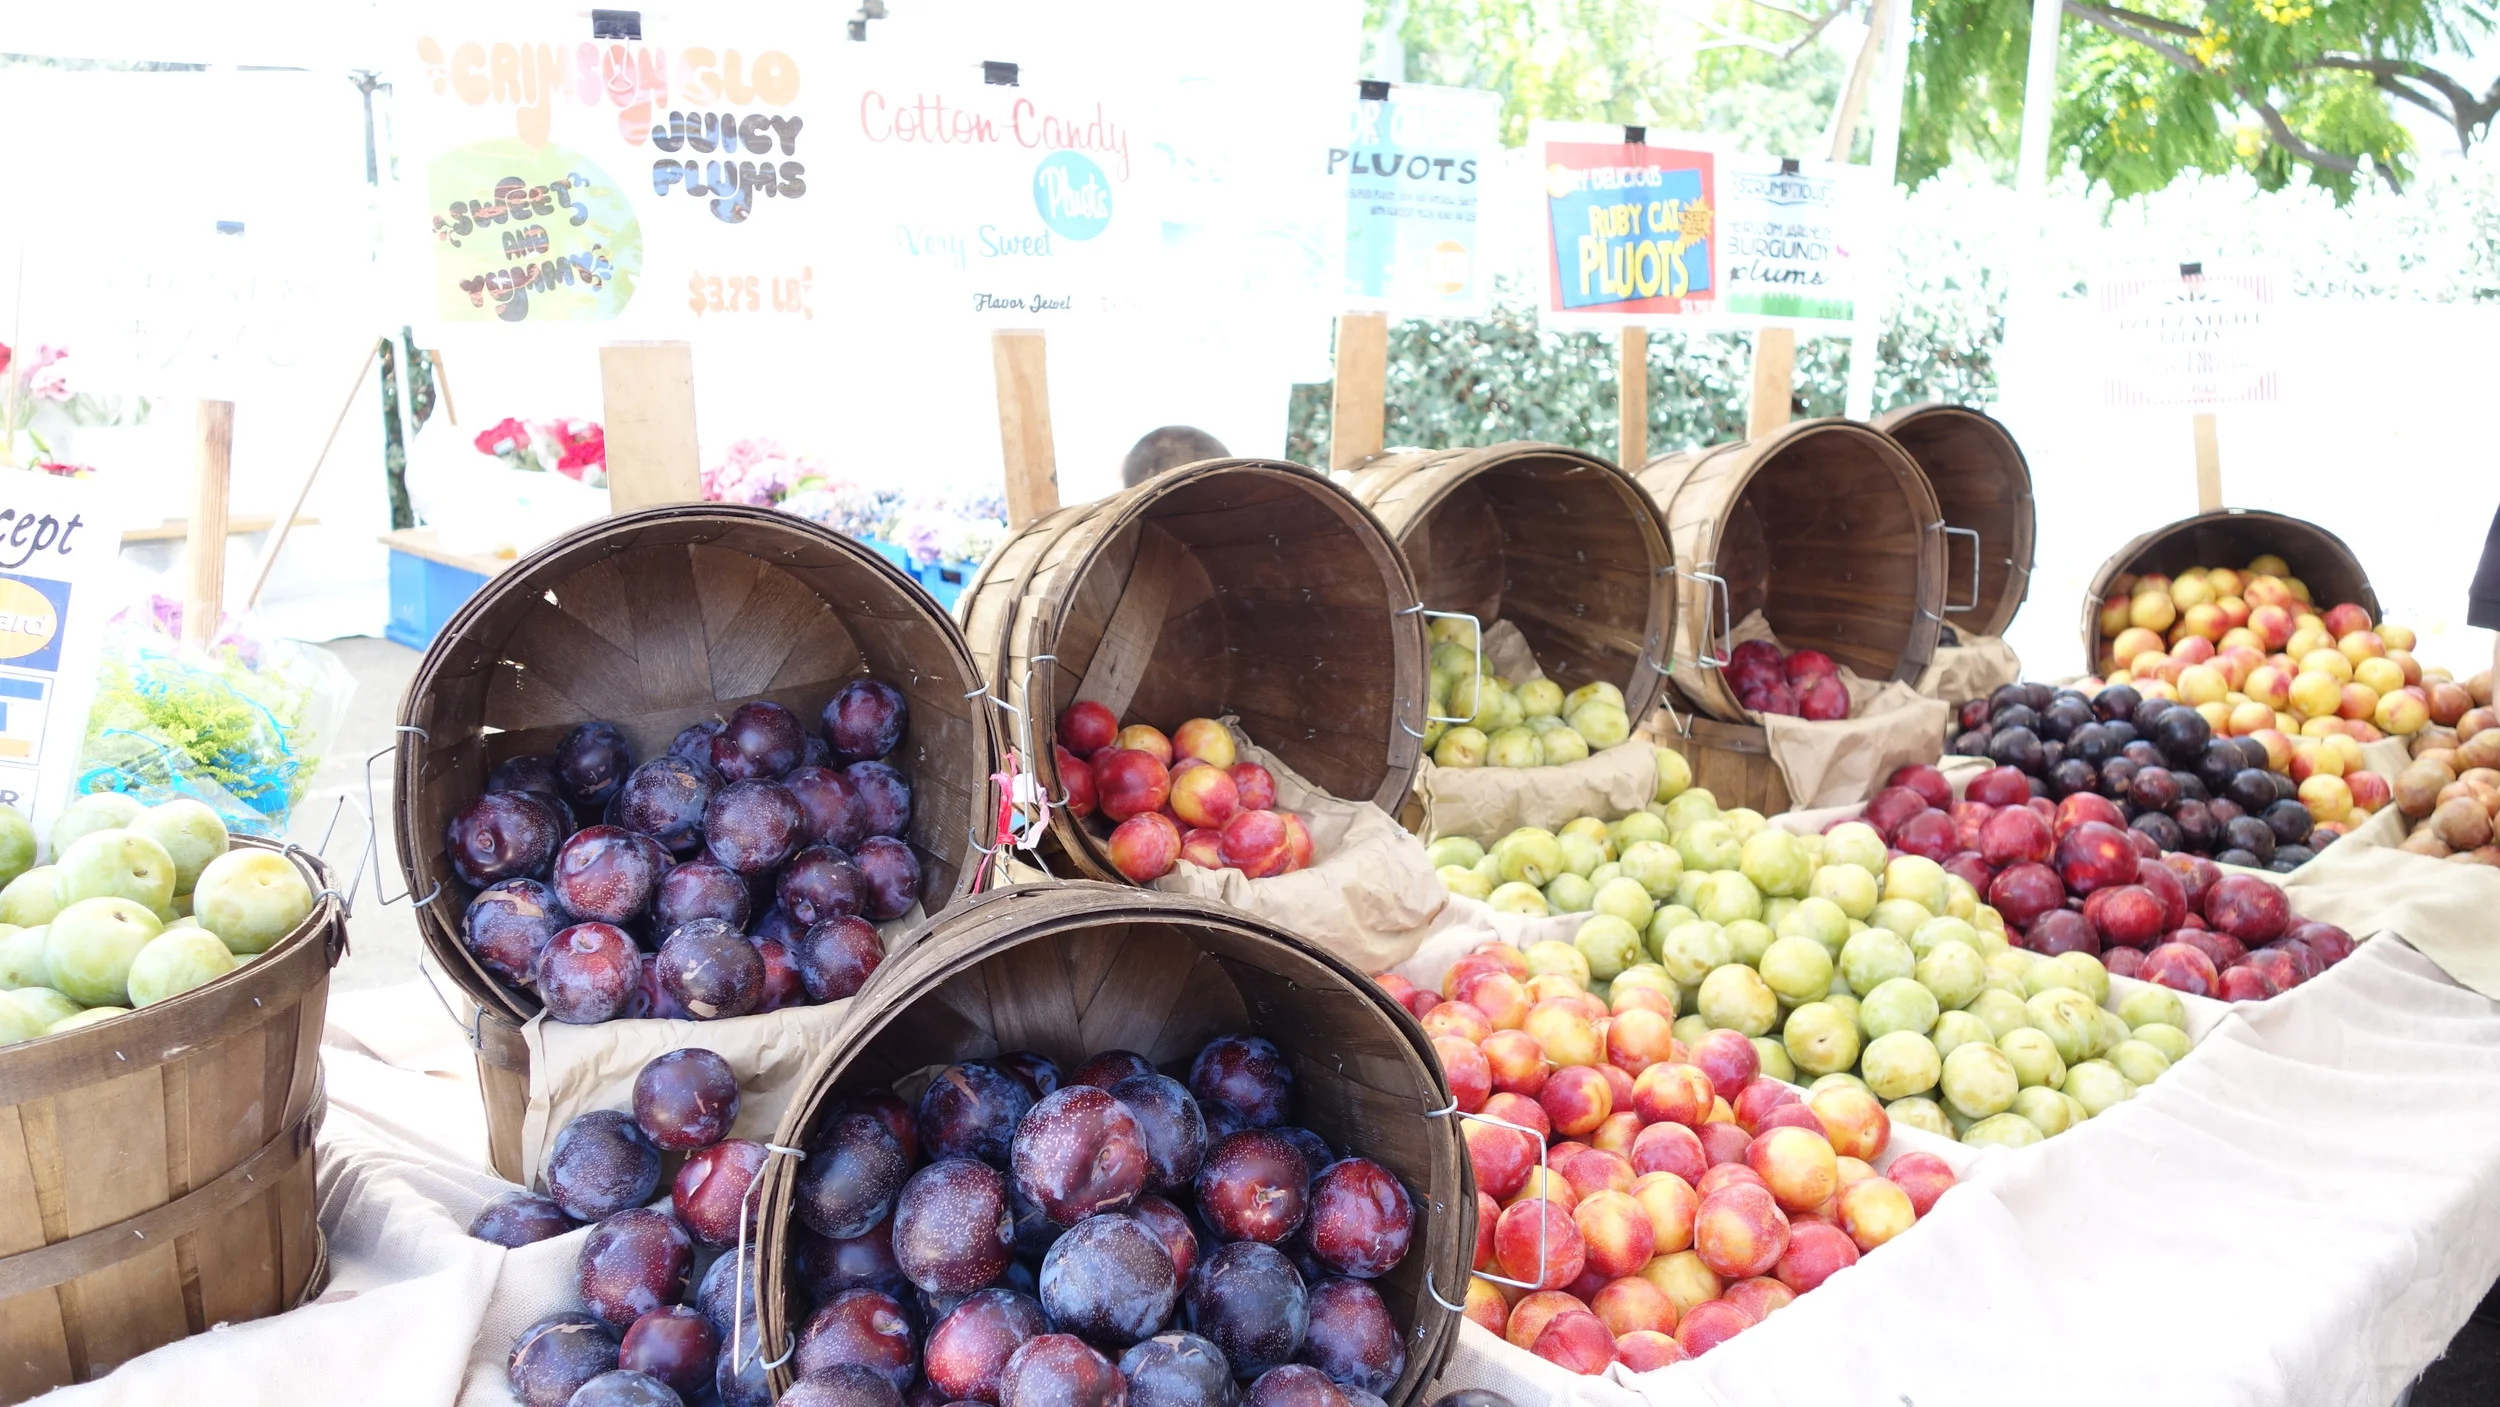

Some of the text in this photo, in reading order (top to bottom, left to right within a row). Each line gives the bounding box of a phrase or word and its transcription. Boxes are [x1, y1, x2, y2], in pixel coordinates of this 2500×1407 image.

[451, 40, 801, 150] CRIMSON GLO
[651, 110, 804, 156] JUICY
[860, 90, 1130, 181] Cotton Candy
[1327, 147, 1478, 184] PLUOTS
[446, 175, 590, 238] SWEET
[652, 158, 806, 224] PLUMS
[501, 223, 550, 260] AND
[1588, 198, 1680, 239] RUBY CAT
[896, 223, 1054, 270] Very Sweet
[1578, 235, 1690, 299] PLUOTS
[1727, 236, 1831, 262] BURGUNDY
[459, 248, 606, 322] YUMMY
[688, 270, 762, 318] $3.75
[1727, 258, 1830, 290] plums
[973, 292, 1073, 312] Flavor Jewel
